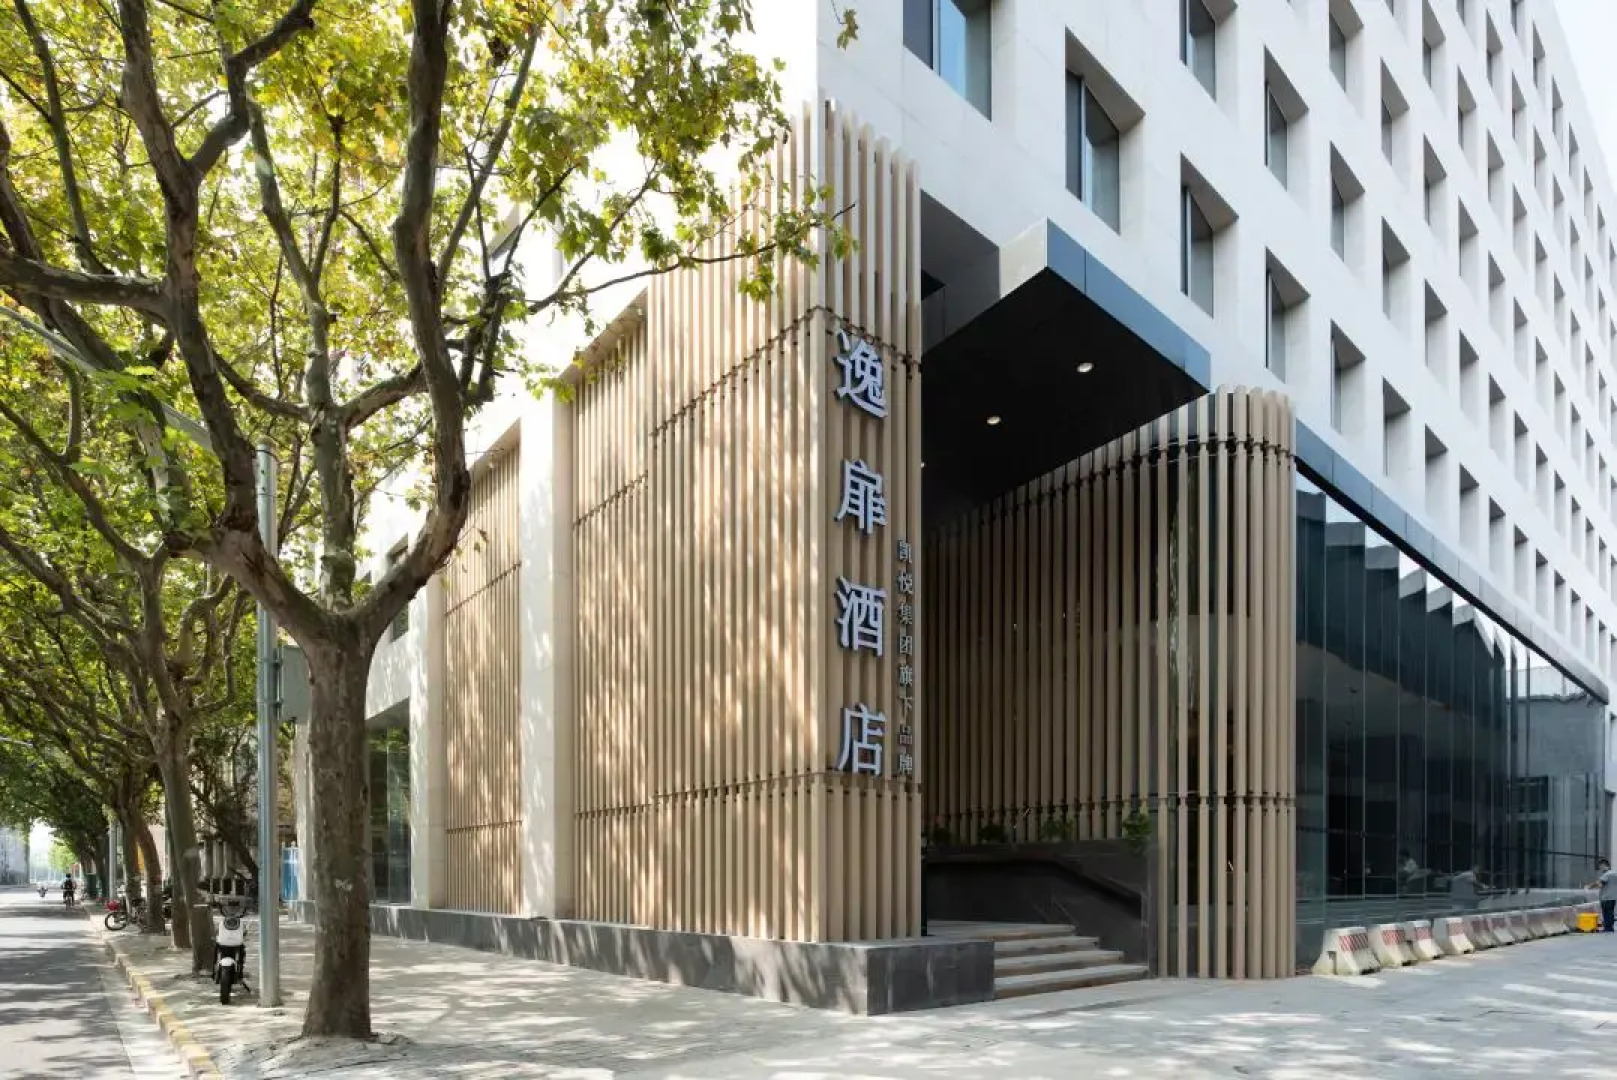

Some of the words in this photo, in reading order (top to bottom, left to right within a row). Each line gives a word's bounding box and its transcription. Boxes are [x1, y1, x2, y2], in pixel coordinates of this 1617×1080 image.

[834, 329, 887, 776] 逸扉酒店
[897, 539, 913, 775] 凯悦集团旗下品牌
